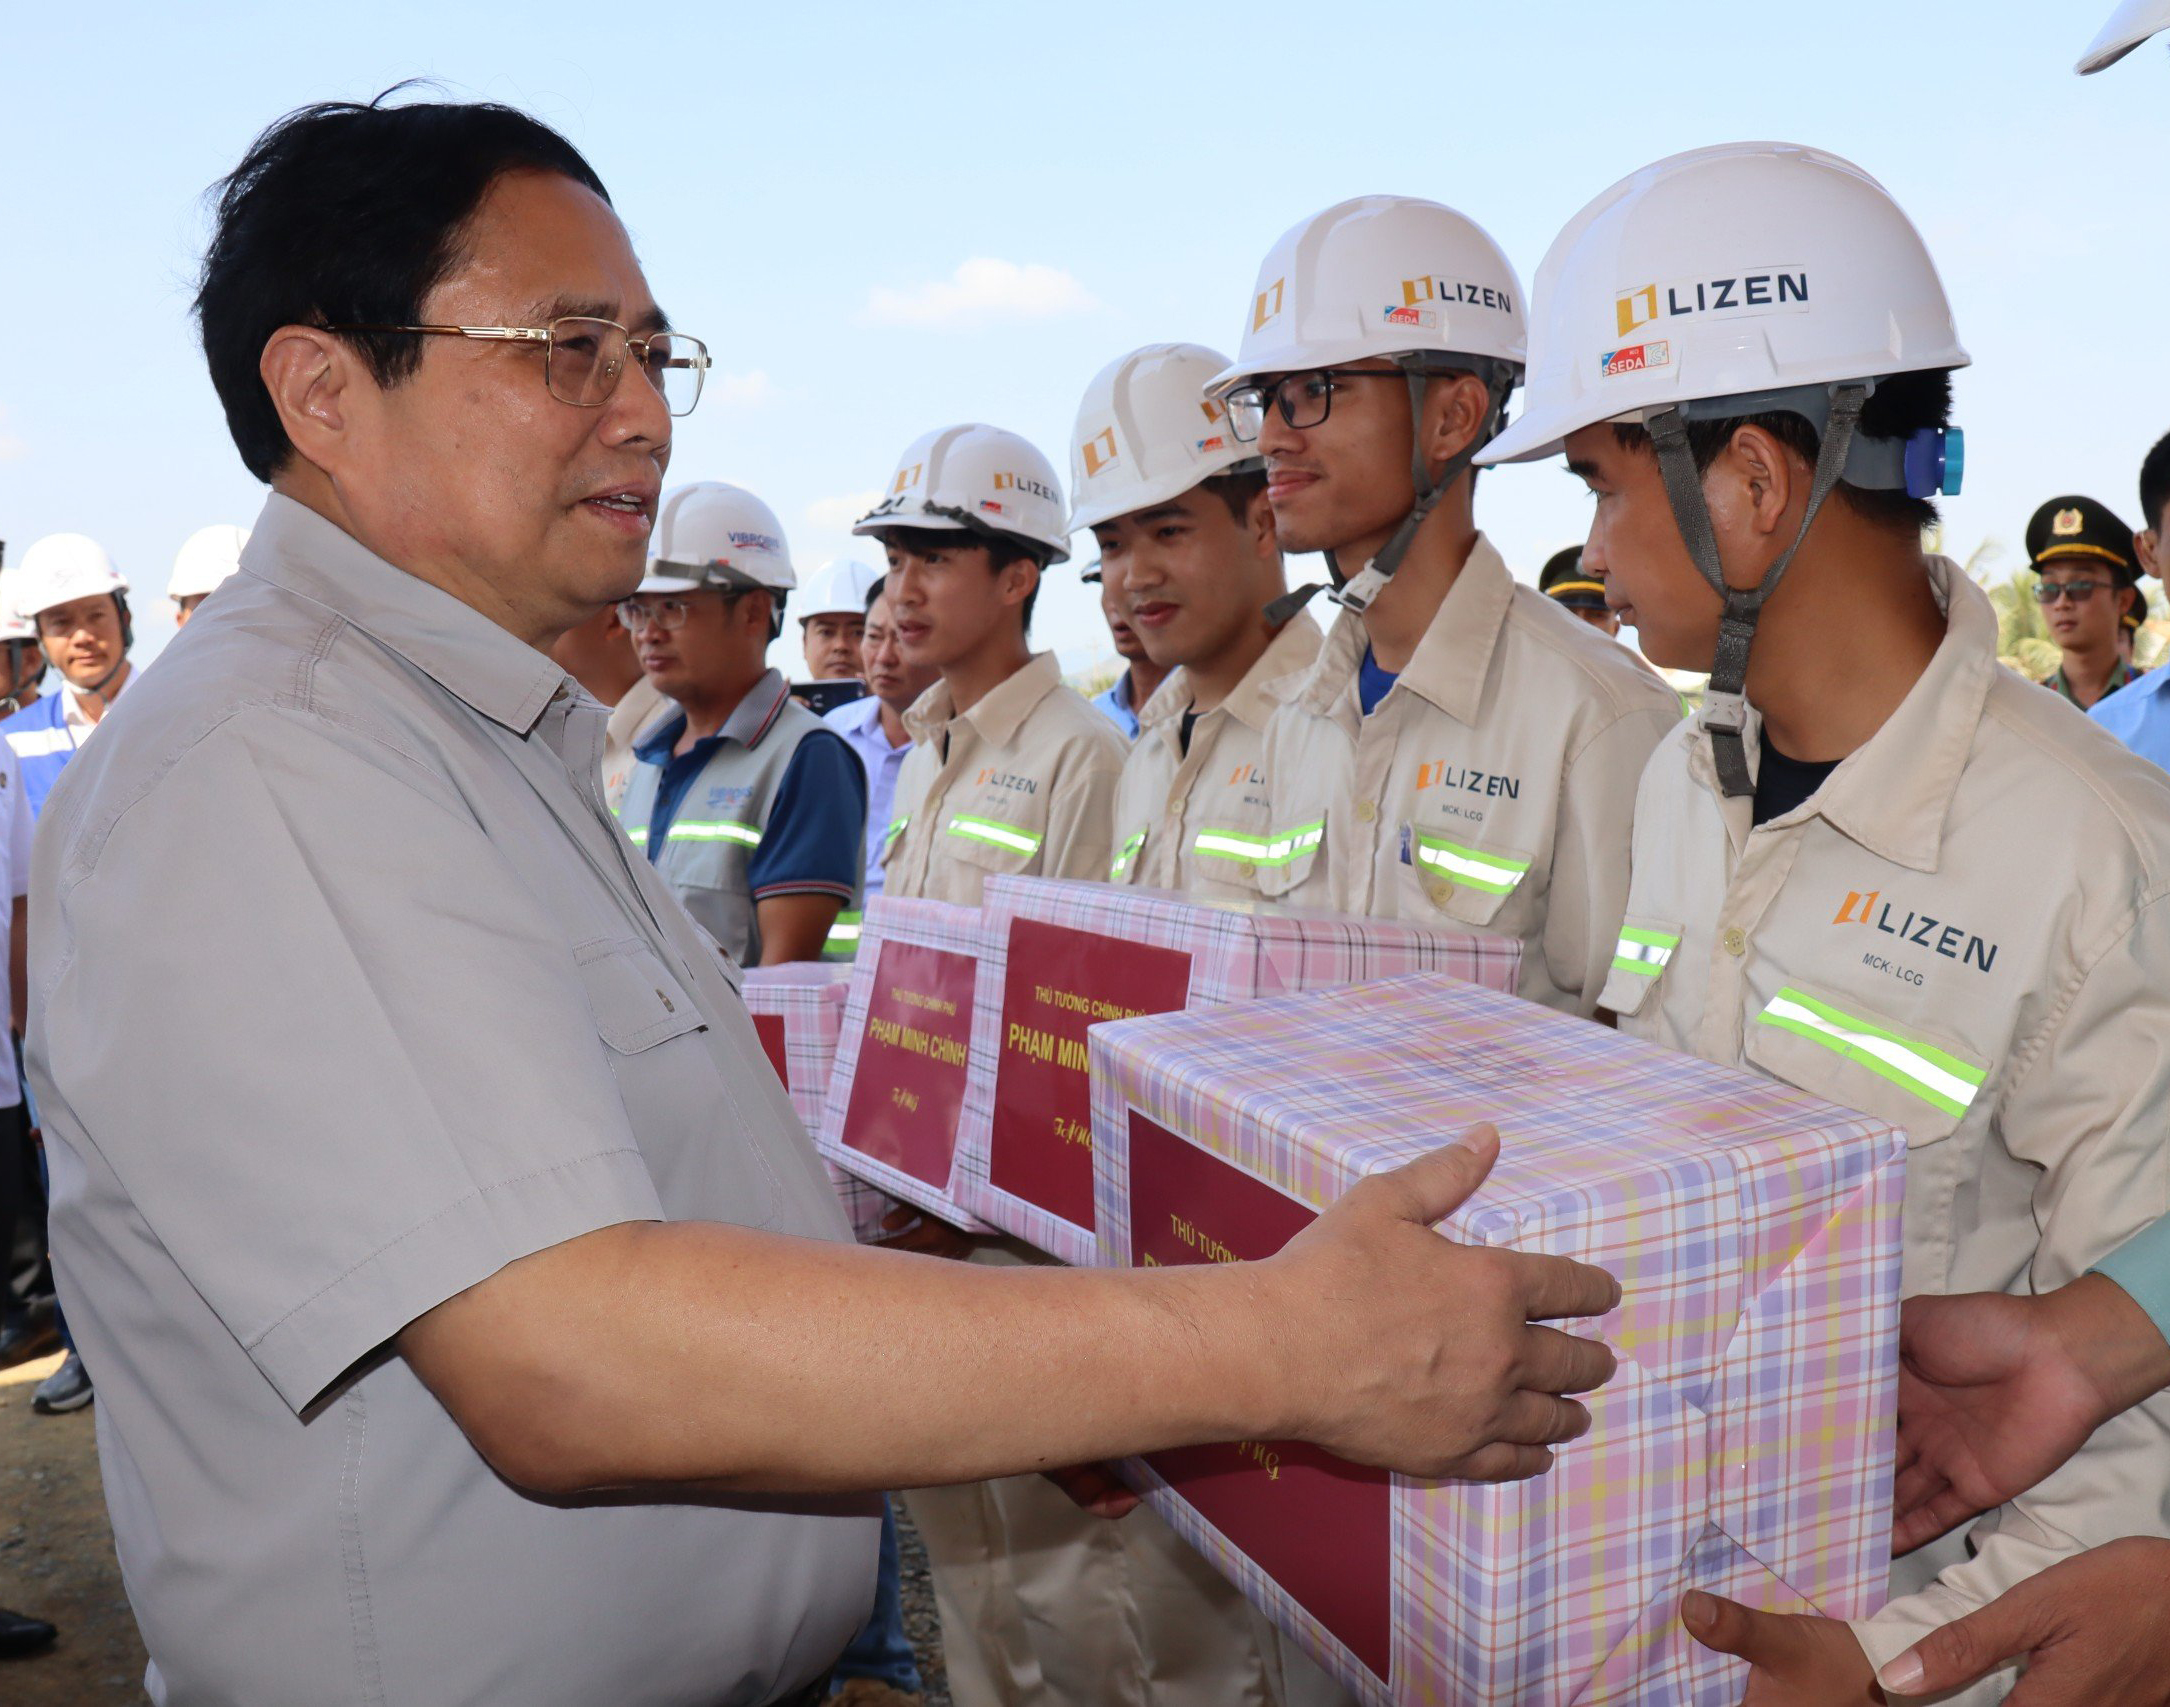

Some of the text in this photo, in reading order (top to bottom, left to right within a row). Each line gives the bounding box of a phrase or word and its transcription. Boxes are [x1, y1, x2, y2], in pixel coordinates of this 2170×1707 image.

[1440, 281, 1512, 314] LIZEN
[1668, 273, 1809, 315] LIZEN
[1016, 477, 1058, 504] LIZEN
[991, 774, 1038, 794] LIZEN
[1445, 766, 1520, 799] LIZEN
[1464, 810, 1483, 822] LCG
[1877, 902, 1998, 973] LIZEN
[1862, 952, 1924, 986] MCK: LCG
[1035, 985, 1053, 1004] THỦ
[1054, 990, 1090, 1014] TƯỚNG
[1091, 999, 1123, 1021] CHÍNH
[868, 1017, 967, 1068] PHẠM MINH CHÍNH
[1008, 1022, 1090, 1074] PHẠM MIN
[1170, 1213, 1195, 1247] THỦ
